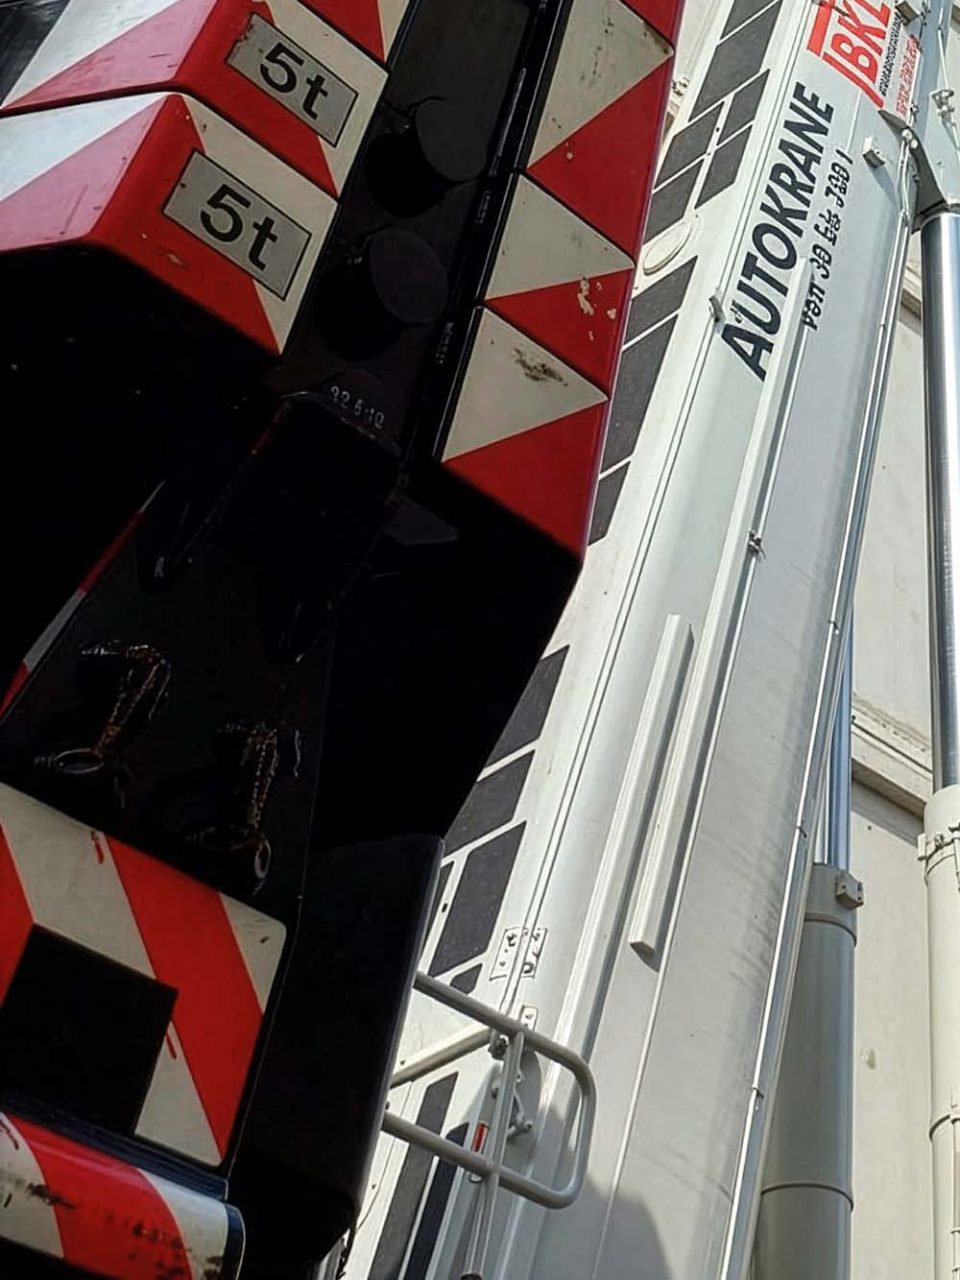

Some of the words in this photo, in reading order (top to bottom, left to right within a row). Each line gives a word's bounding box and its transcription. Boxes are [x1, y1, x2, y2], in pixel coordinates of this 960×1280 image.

[258, 42, 329, 120] 5t
[199, 184, 281, 271] 5t
[721, 82, 834, 382] AUTOKRANE
